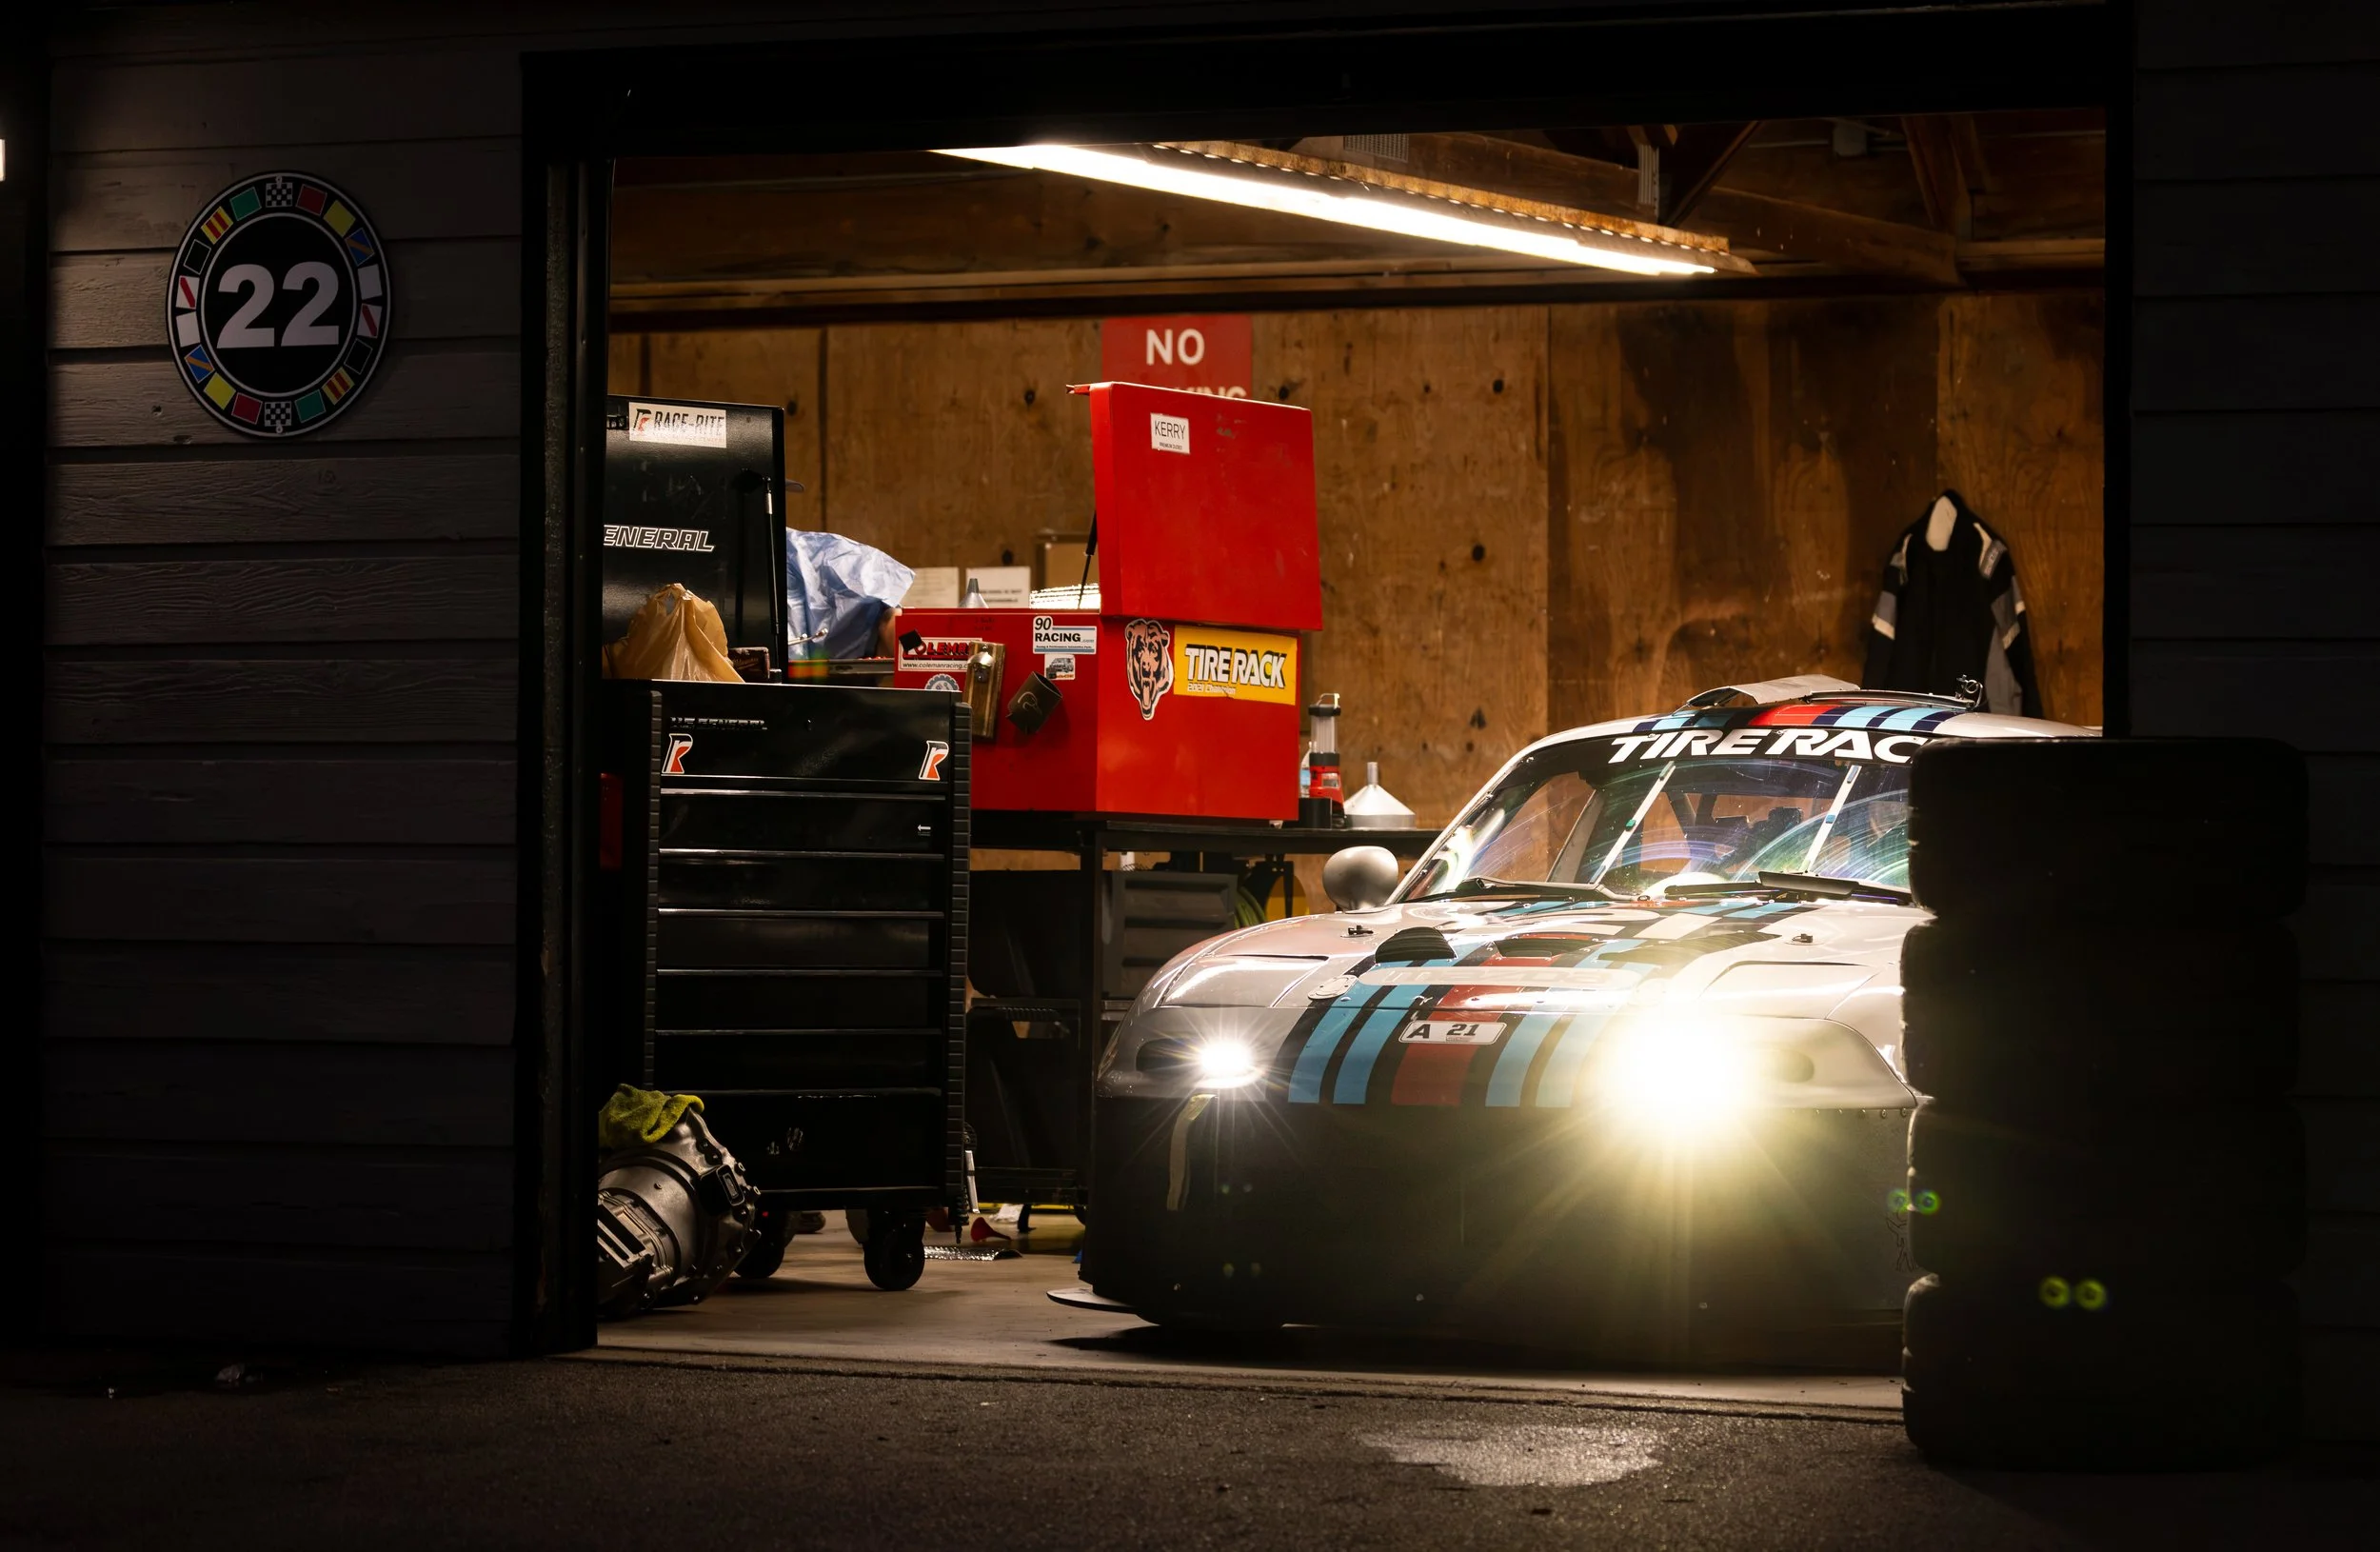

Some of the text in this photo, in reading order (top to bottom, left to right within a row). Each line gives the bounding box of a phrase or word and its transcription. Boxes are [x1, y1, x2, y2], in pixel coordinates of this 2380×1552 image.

[217, 261, 340, 349] 22
[1146, 328, 1205, 366] NO
[1154, 420, 1186, 440] KERRY
[604, 524, 715, 552] ENERAL
[1034, 617, 1052, 630] 90
[1035, 632, 1081, 643] RACING
[902, 661, 969, 670] www.colemanracing.c
[1184, 643, 1288, 689] TIRE RACK
[1607, 728, 1930, 764] TIRE RAC
[1406, 1024, 1479, 1039] A 21
